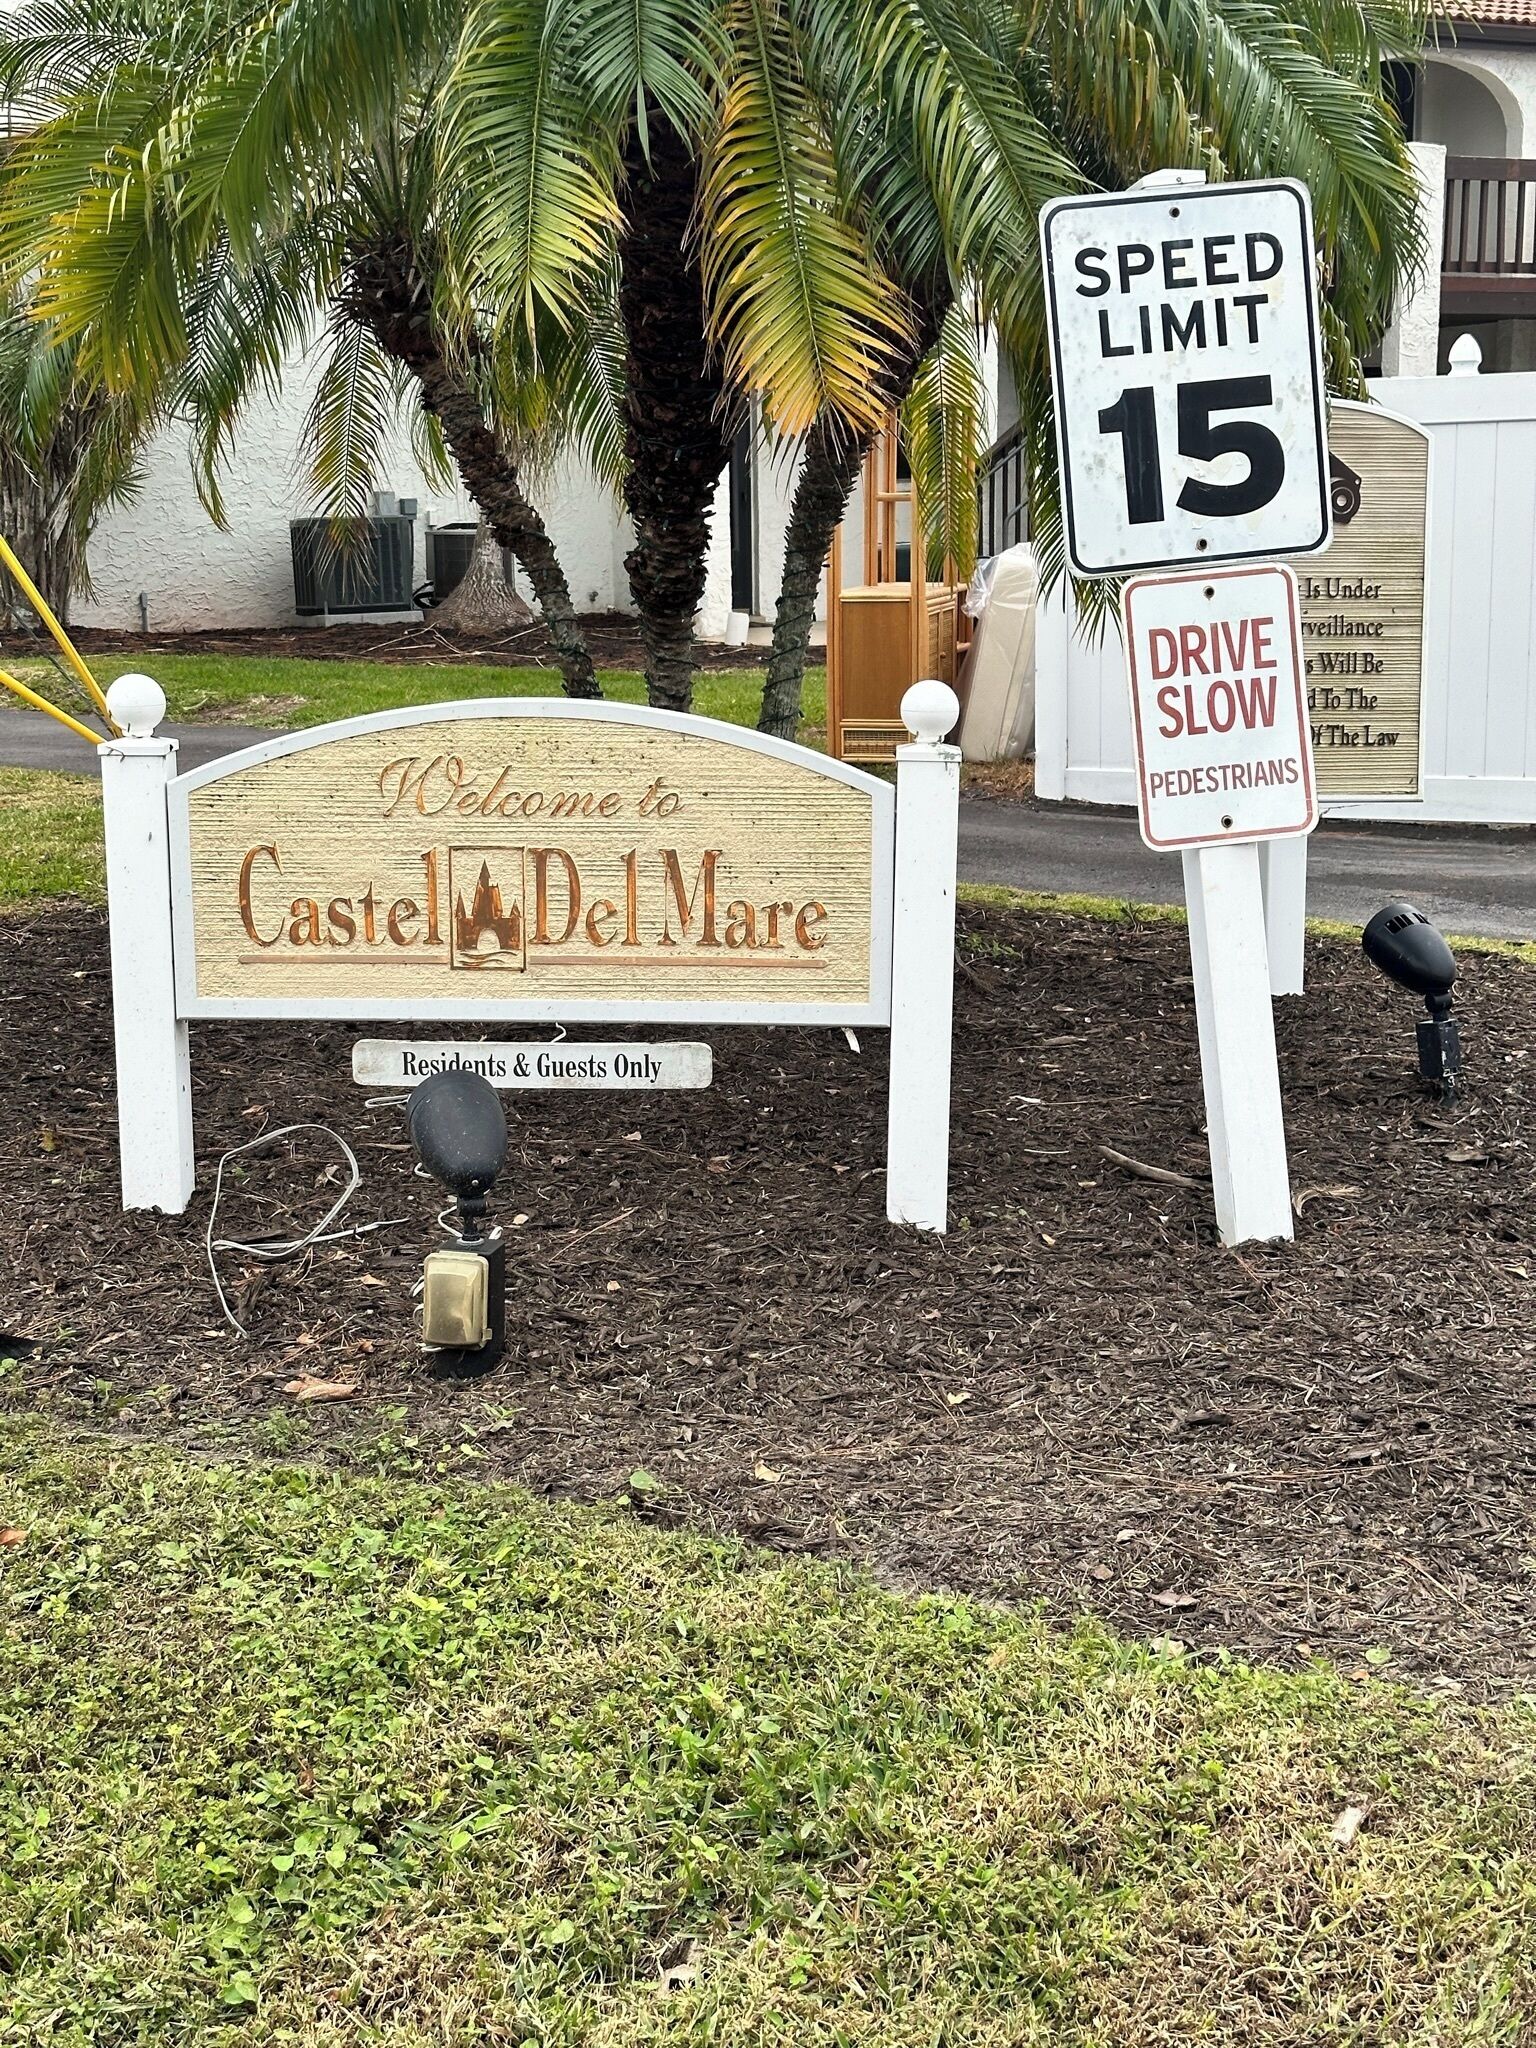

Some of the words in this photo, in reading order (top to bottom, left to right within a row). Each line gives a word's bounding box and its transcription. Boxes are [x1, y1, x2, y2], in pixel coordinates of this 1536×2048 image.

[1074, 232, 1284, 298] SPEED
[1098, 293, 1269, 358] LIMIT
[1097, 374, 1286, 526] 15
[1305, 577, 1321, 599] Is
[1325, 577, 1382, 599] Under
[1148, 616, 1278, 680] DRIVE
[1301, 615, 1384, 637] rveillance
[1318, 652, 1357, 674] Will
[1361, 652, 1384, 674] Be
[1156, 675, 1277, 739] SLOW
[1320, 687, 1341, 709] To
[1345, 687, 1378, 709] The
[1326, 724, 1359, 747] The
[1363, 724, 1400, 747] Law
[378, 755, 624, 819] Welcome
[637, 777, 686, 818] to
[1149, 757, 1299, 799] PEDESTRIANS
[238, 841, 444, 948] Castel
[527, 847, 643, 946] Del
[658, 847, 829, 951] Mare
[402, 1051, 506, 1077] Residents
[513, 1053, 531, 1077] &
[537, 1053, 607, 1079] Guests
[614, 1053, 662, 1083] Only
